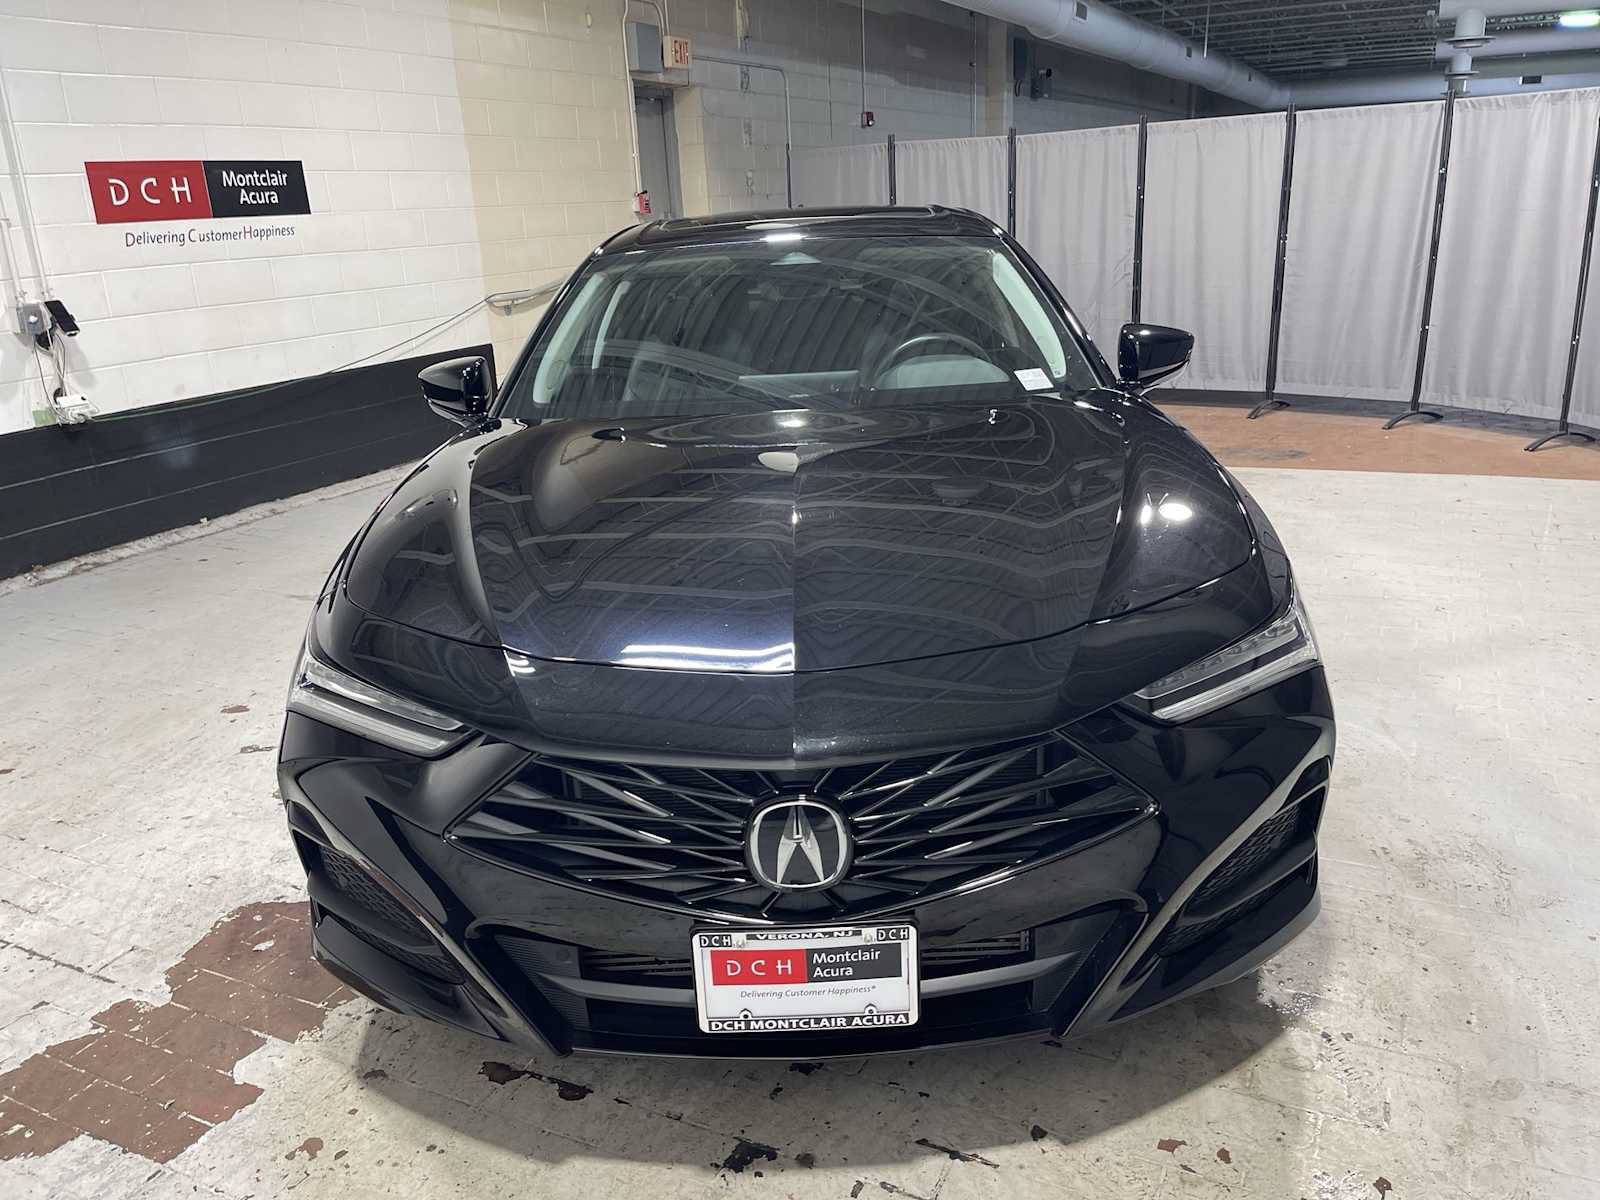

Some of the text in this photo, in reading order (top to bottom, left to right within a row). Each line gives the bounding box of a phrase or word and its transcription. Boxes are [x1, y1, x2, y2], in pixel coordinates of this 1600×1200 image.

[222, 170, 288, 187] Montclair
[240, 189, 279, 205] Acura
[125, 231, 186, 247] Delivering
[833, 930, 854, 938] NJ
[813, 949, 881, 964] Montclair
[813, 967, 853, 978] Acura
[740, 990, 783, 999] Delivering
[785, 988, 826, 997] Customer
[711, 1013, 907, 1031] DCH MONTCLAIR ACURA
